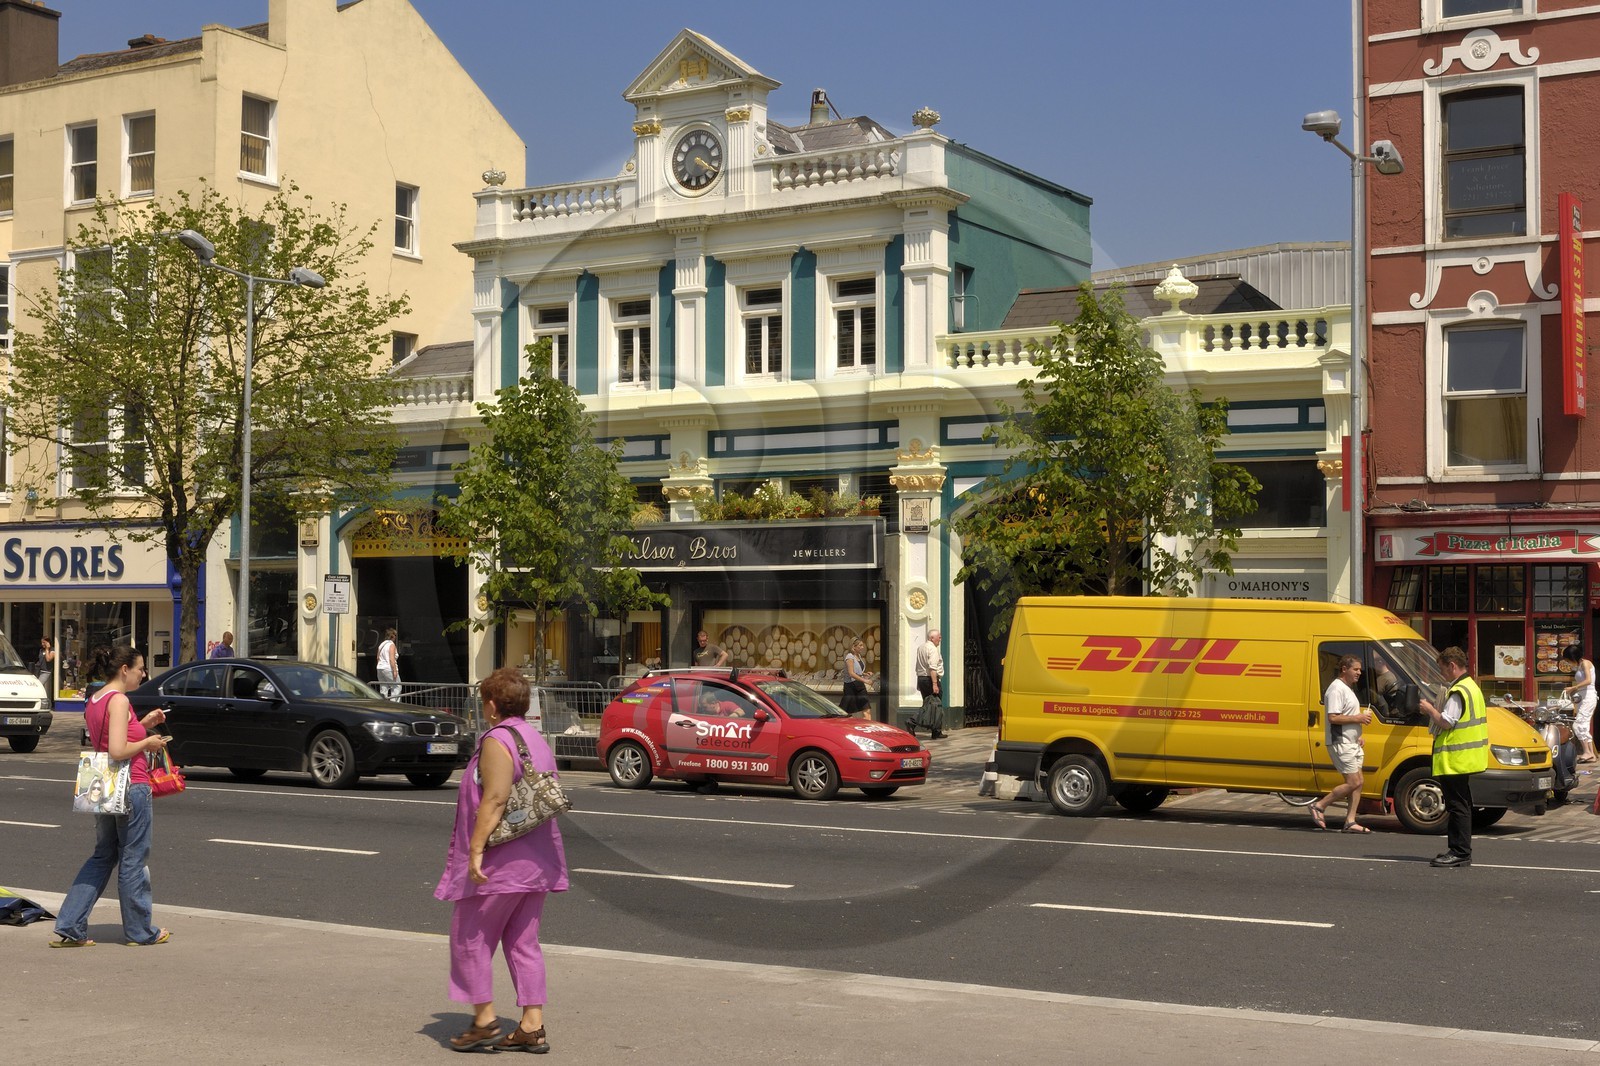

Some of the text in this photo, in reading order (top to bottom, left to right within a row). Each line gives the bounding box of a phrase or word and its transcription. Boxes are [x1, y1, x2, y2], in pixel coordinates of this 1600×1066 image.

[1573, 237, 1584, 370] RESTAURANT
[1448, 534, 1562, 551] Pizza d'Italia
[690, 537, 737, 560] Bros
[793, 548, 846, 558] JEWELLERS
[334, 583, 341, 593] L
[1228, 581, 1310, 592] O'MAHONY'S
[1076, 636, 1249, 676] DHL
[1054, 704, 1080, 714] Express
[1082, 705, 1088, 713] &
[1138, 708, 1151, 716] Call
[1220, 712, 1266, 721] www.dhl.ie
[696, 737, 751, 749] telecom
[706, 758, 729, 769] 1800
[731, 760, 747, 770] 931
[750, 762, 769, 772] 300
